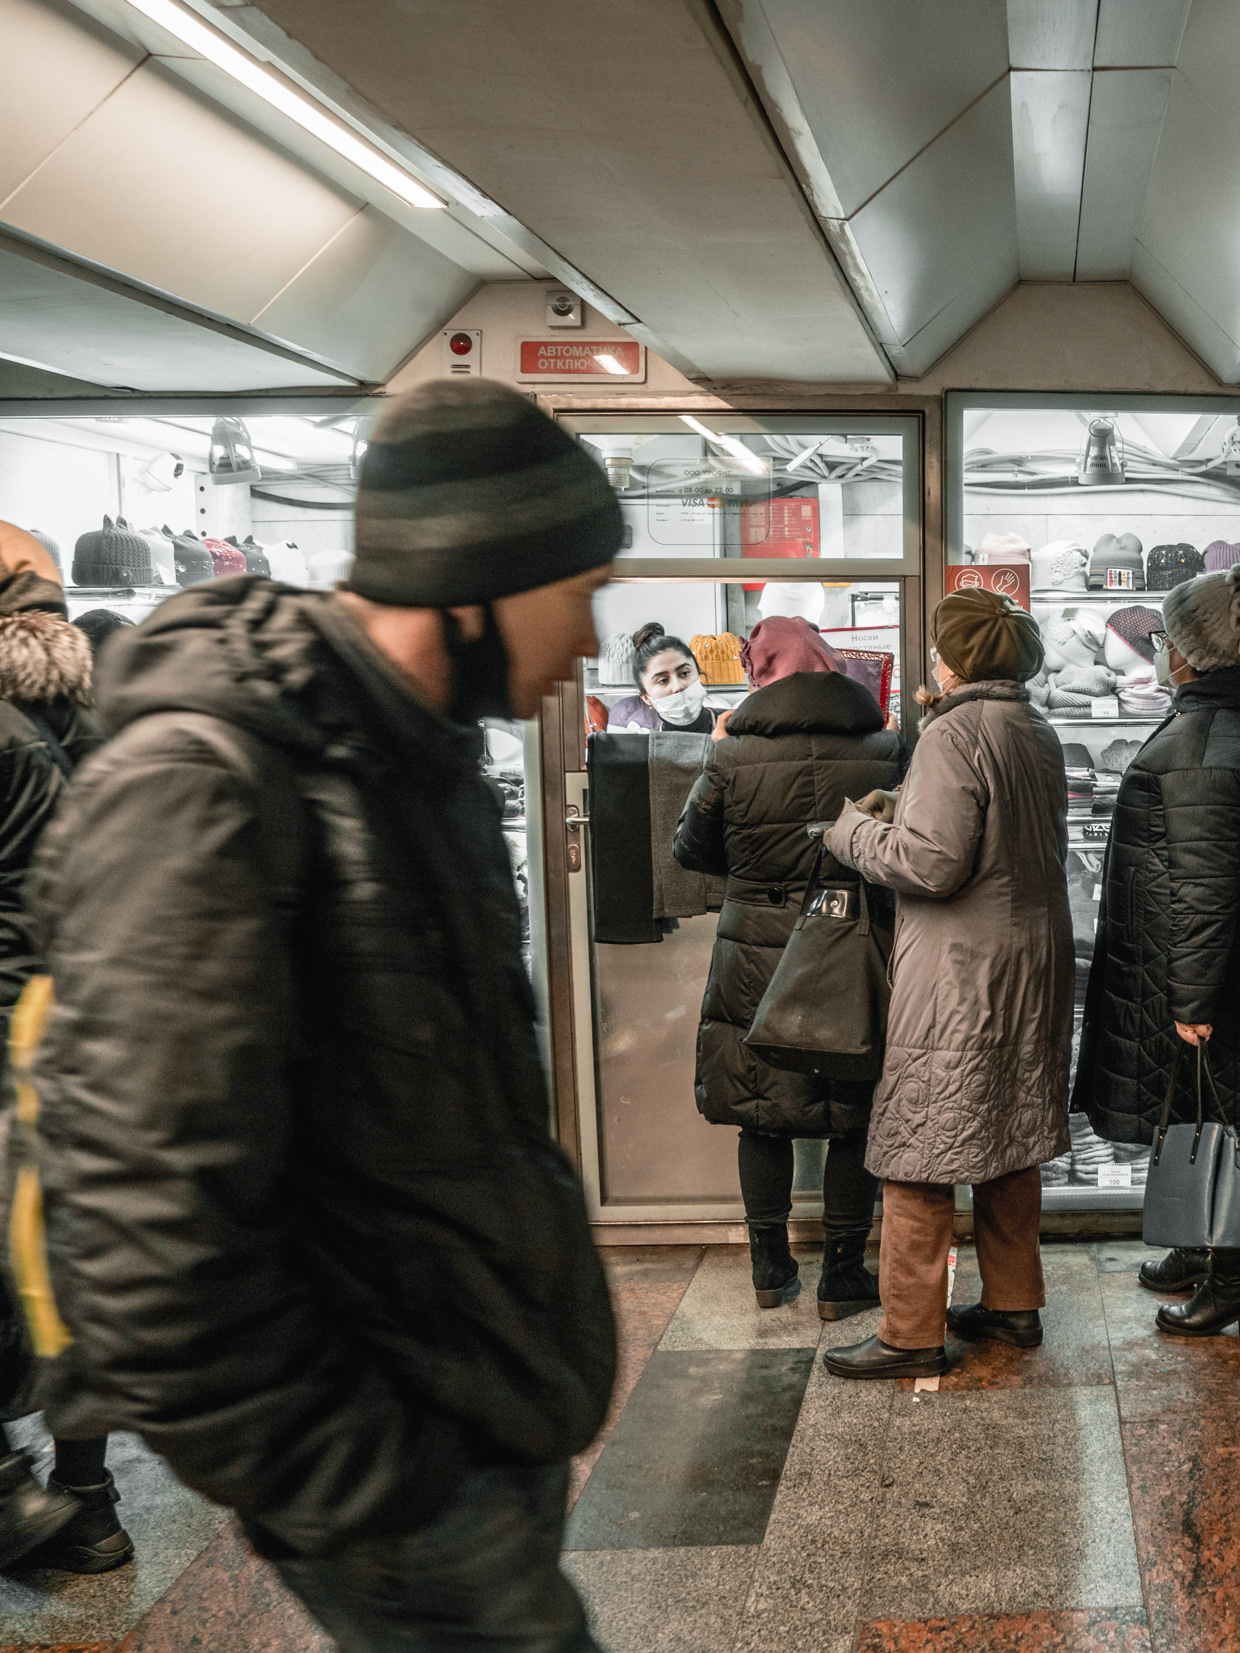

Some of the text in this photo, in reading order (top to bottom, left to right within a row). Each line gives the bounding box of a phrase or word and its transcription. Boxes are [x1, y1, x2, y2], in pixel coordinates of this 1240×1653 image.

[537, 345, 625, 357] АВТОМАТИКА
[680, 498, 705, 508] VISA
[851, 634, 879, 642] Носки
